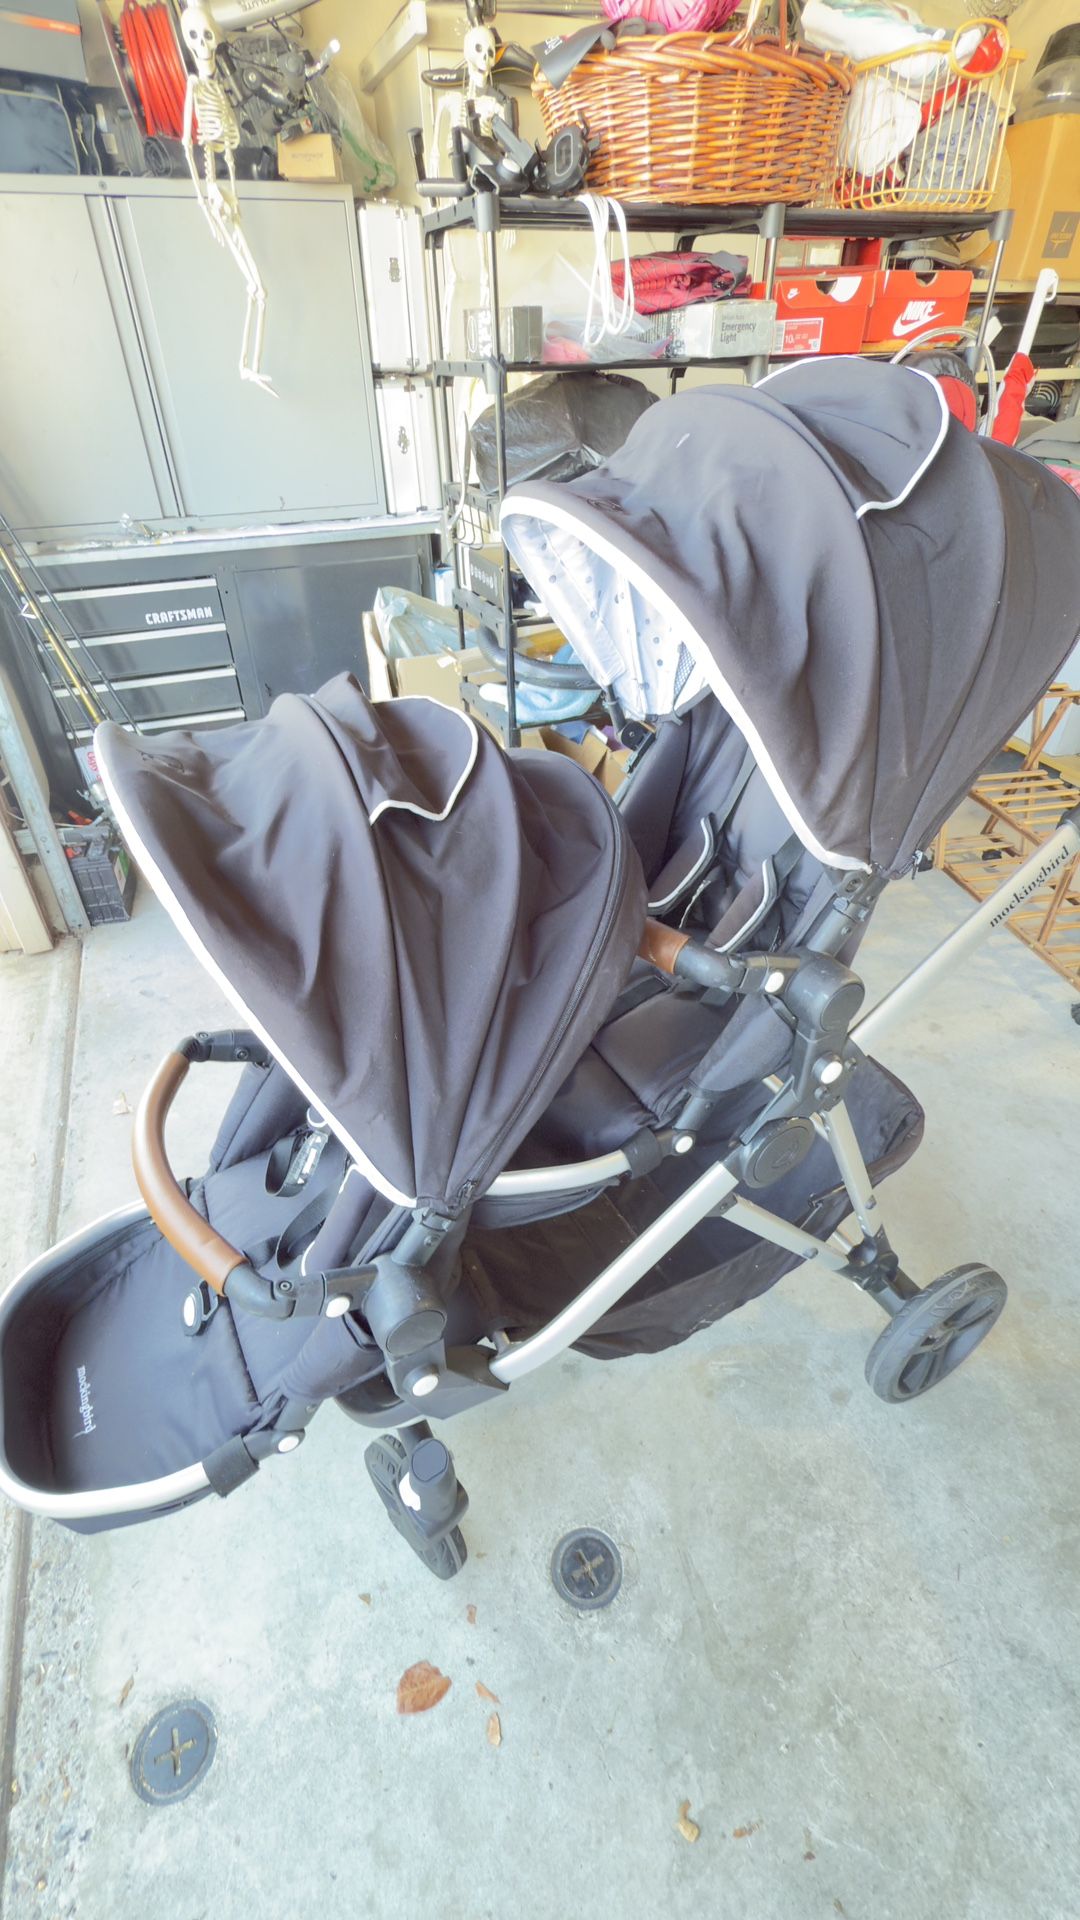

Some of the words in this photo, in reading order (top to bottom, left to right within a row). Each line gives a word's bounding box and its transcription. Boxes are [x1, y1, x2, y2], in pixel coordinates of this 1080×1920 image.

[901, 300, 937, 321] NIKE
[721, 321, 757, 333] Emergency
[720, 332, 737, 344] Light
[145, 606, 213, 625] CRAFTSMAN
[990, 845, 1069, 928] mockingbird
[76, 1365, 96, 1435] mockingbird
